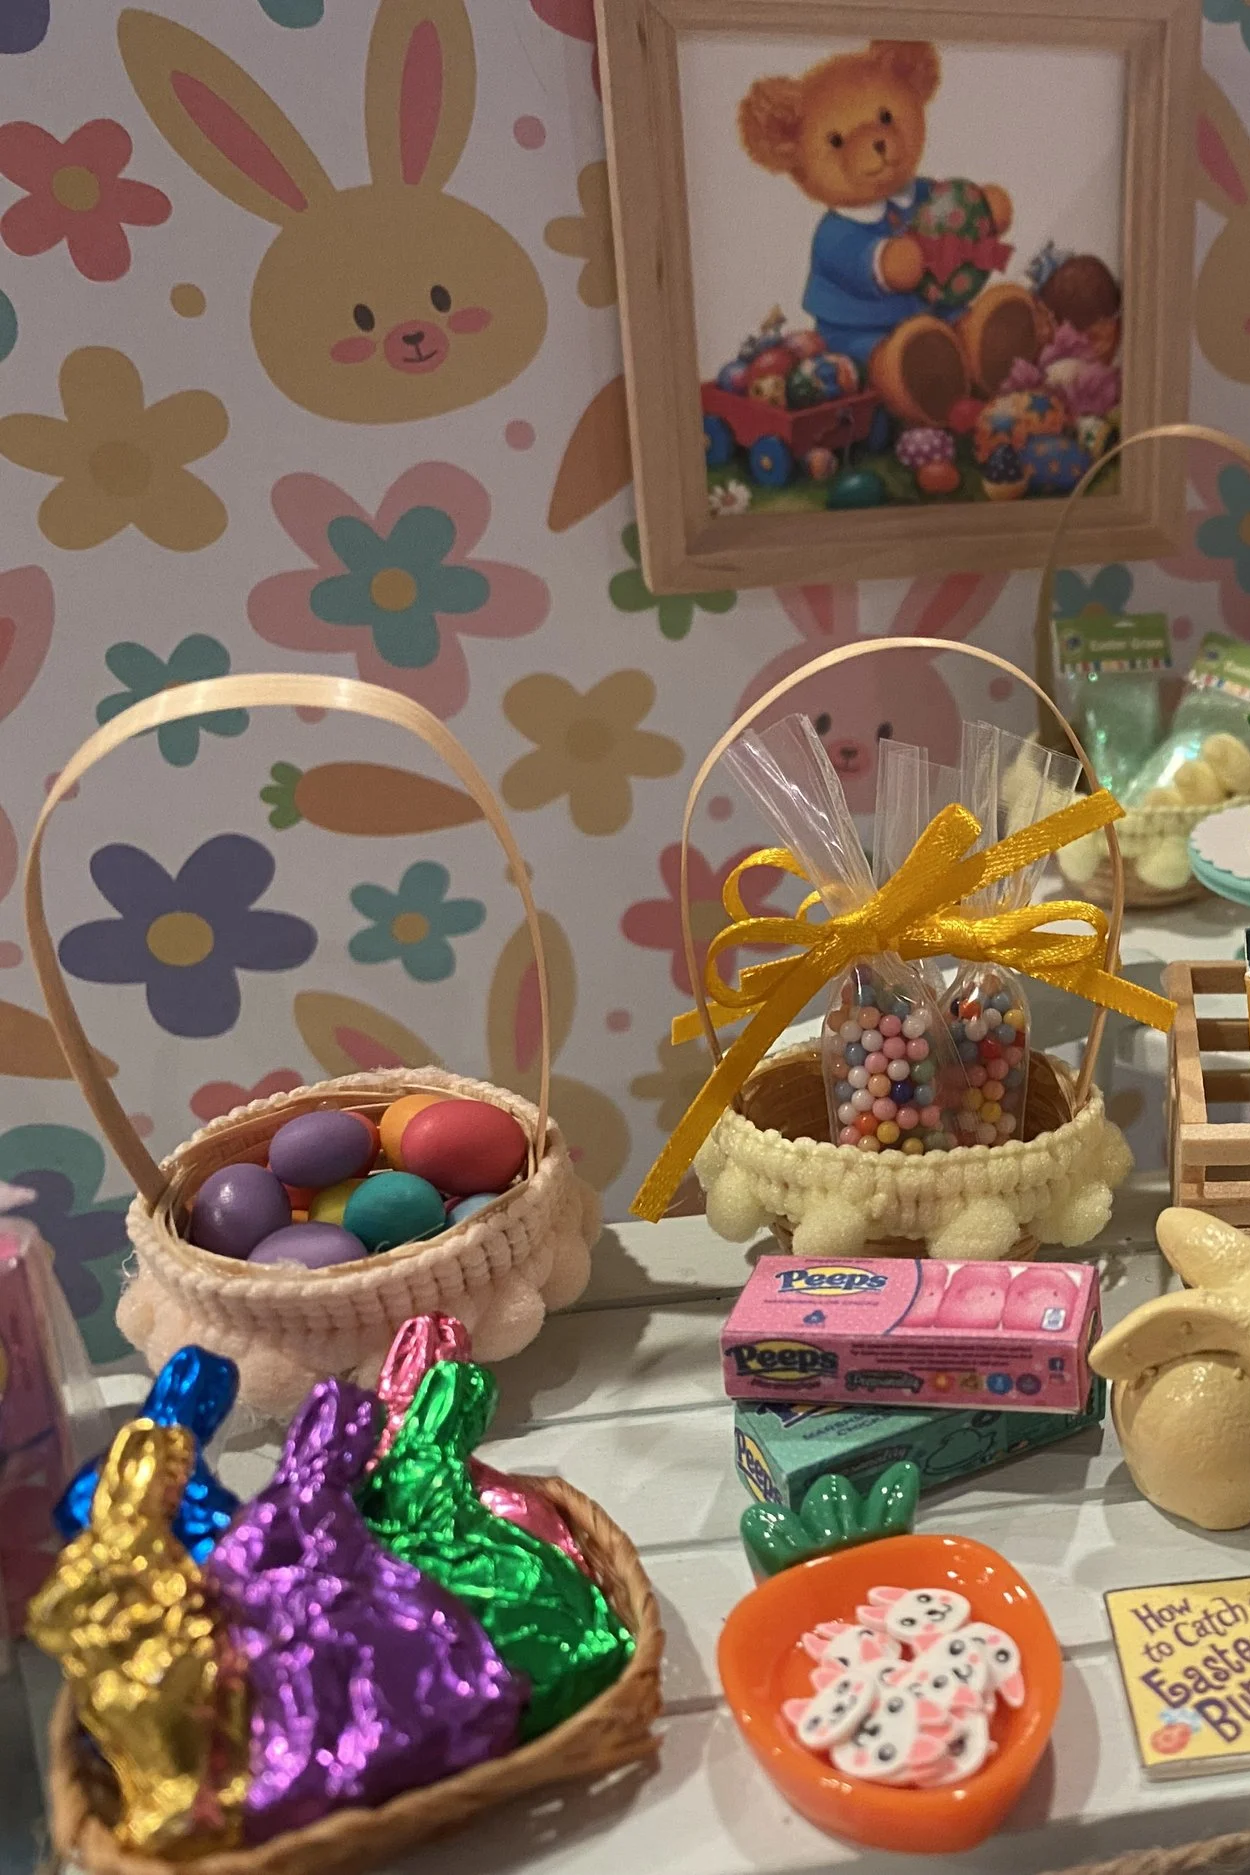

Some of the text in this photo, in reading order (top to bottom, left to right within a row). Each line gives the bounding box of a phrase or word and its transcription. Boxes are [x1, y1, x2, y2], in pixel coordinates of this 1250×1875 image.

[775, 1269, 888, 1291] Peeps
[724, 1343, 839, 1373] Peeps
[1130, 1598, 1192, 1634] How
[1143, 1640, 1175, 1663] to
[1173, 1597, 1250, 1648] Catch
